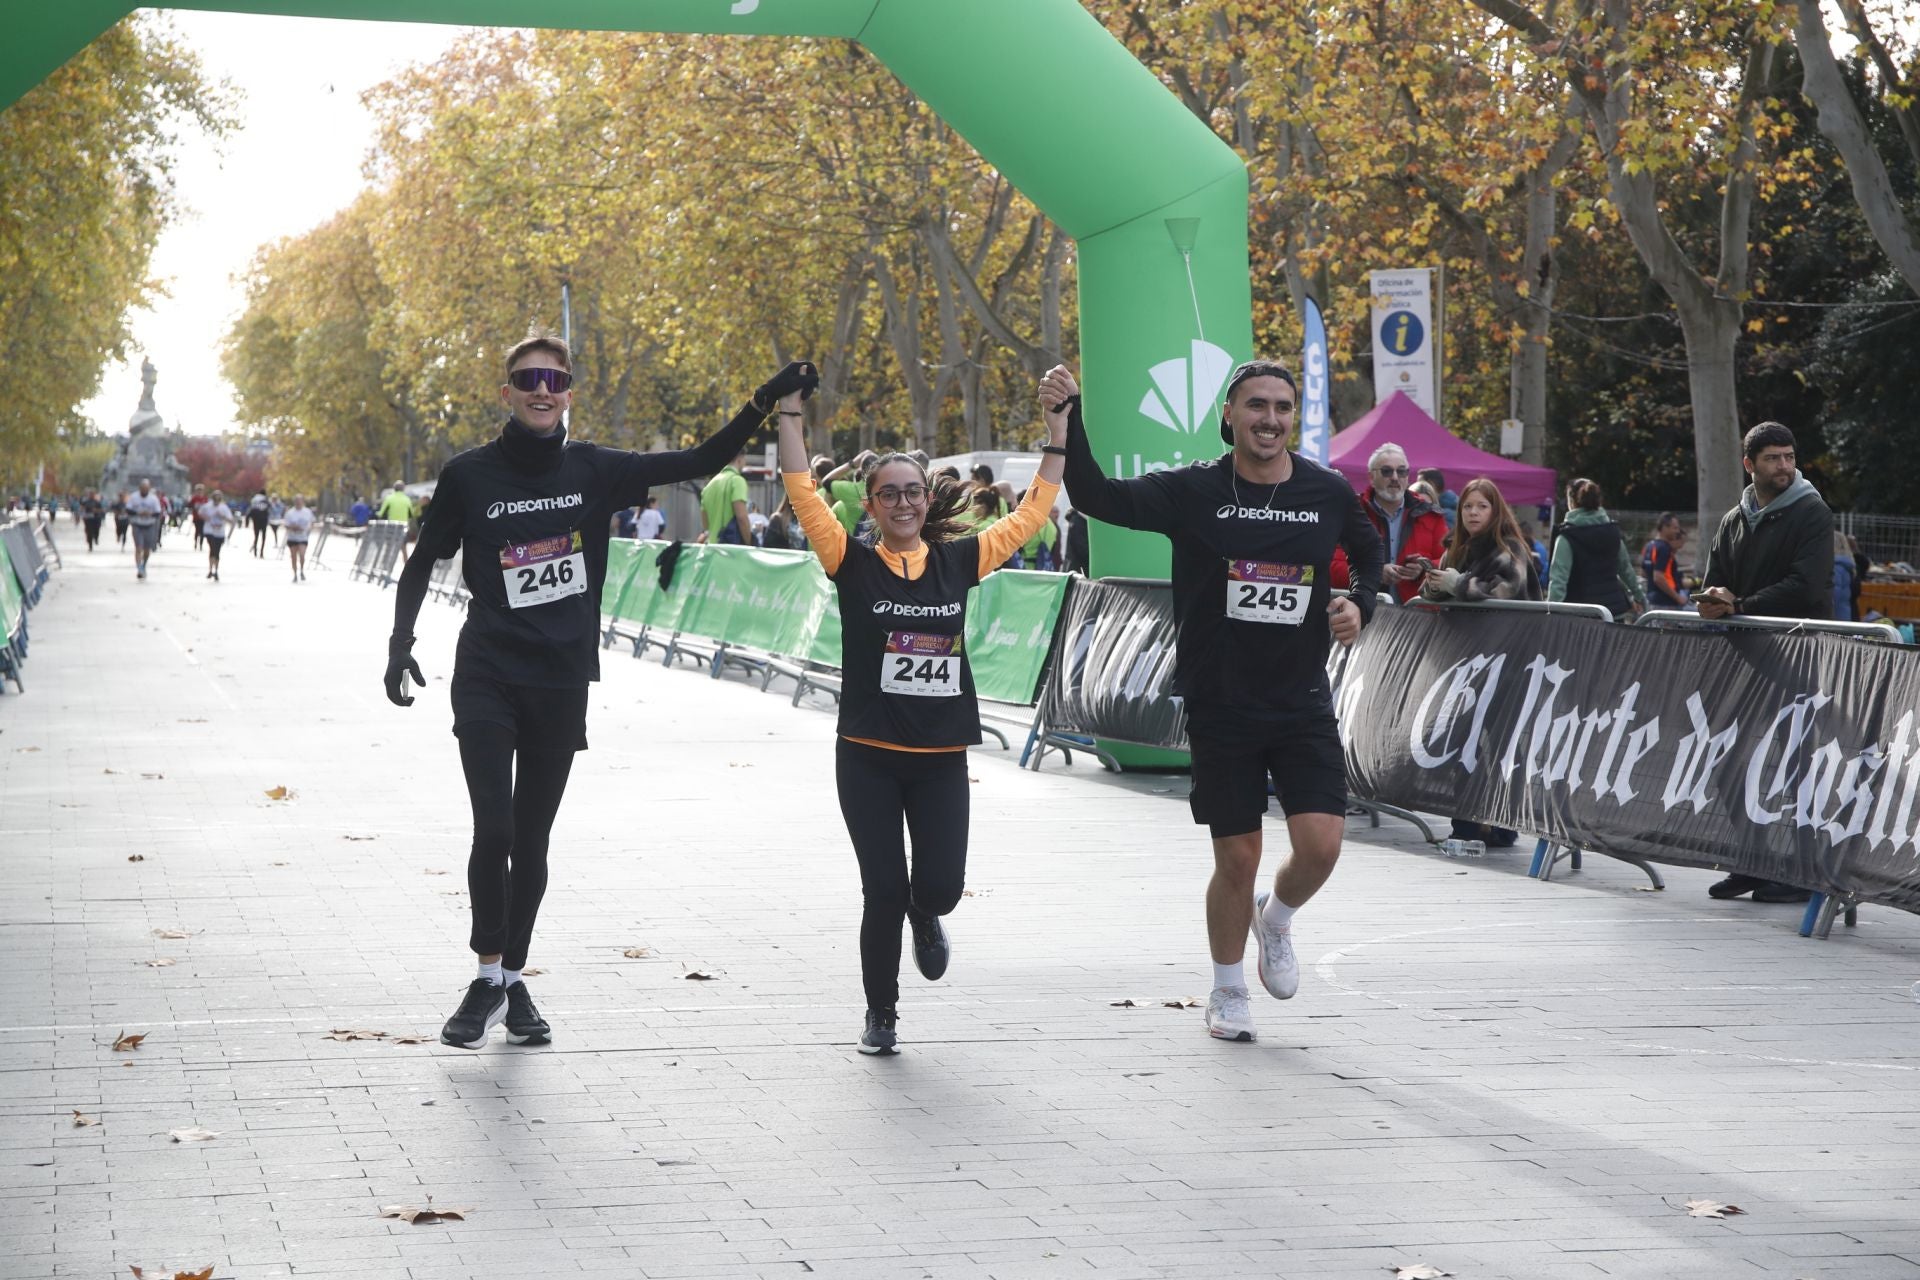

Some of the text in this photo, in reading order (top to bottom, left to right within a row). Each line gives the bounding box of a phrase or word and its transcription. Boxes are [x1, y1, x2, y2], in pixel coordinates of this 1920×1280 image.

[1404, 278, 1414, 286] de
[507, 493, 582, 514] DECATHLON
[1238, 507, 1319, 523] DECATHLON
[517, 559, 574, 594] 246
[893, 602, 962, 617] DECATHLON
[1238, 584, 1298, 611] 245
[893, 656, 950, 684] 244
[1410, 653, 1507, 774] El
[1501, 653, 1660, 807] Norte
[1661, 691, 1738, 815] de
[1745, 688, 1920, 858] Casti
